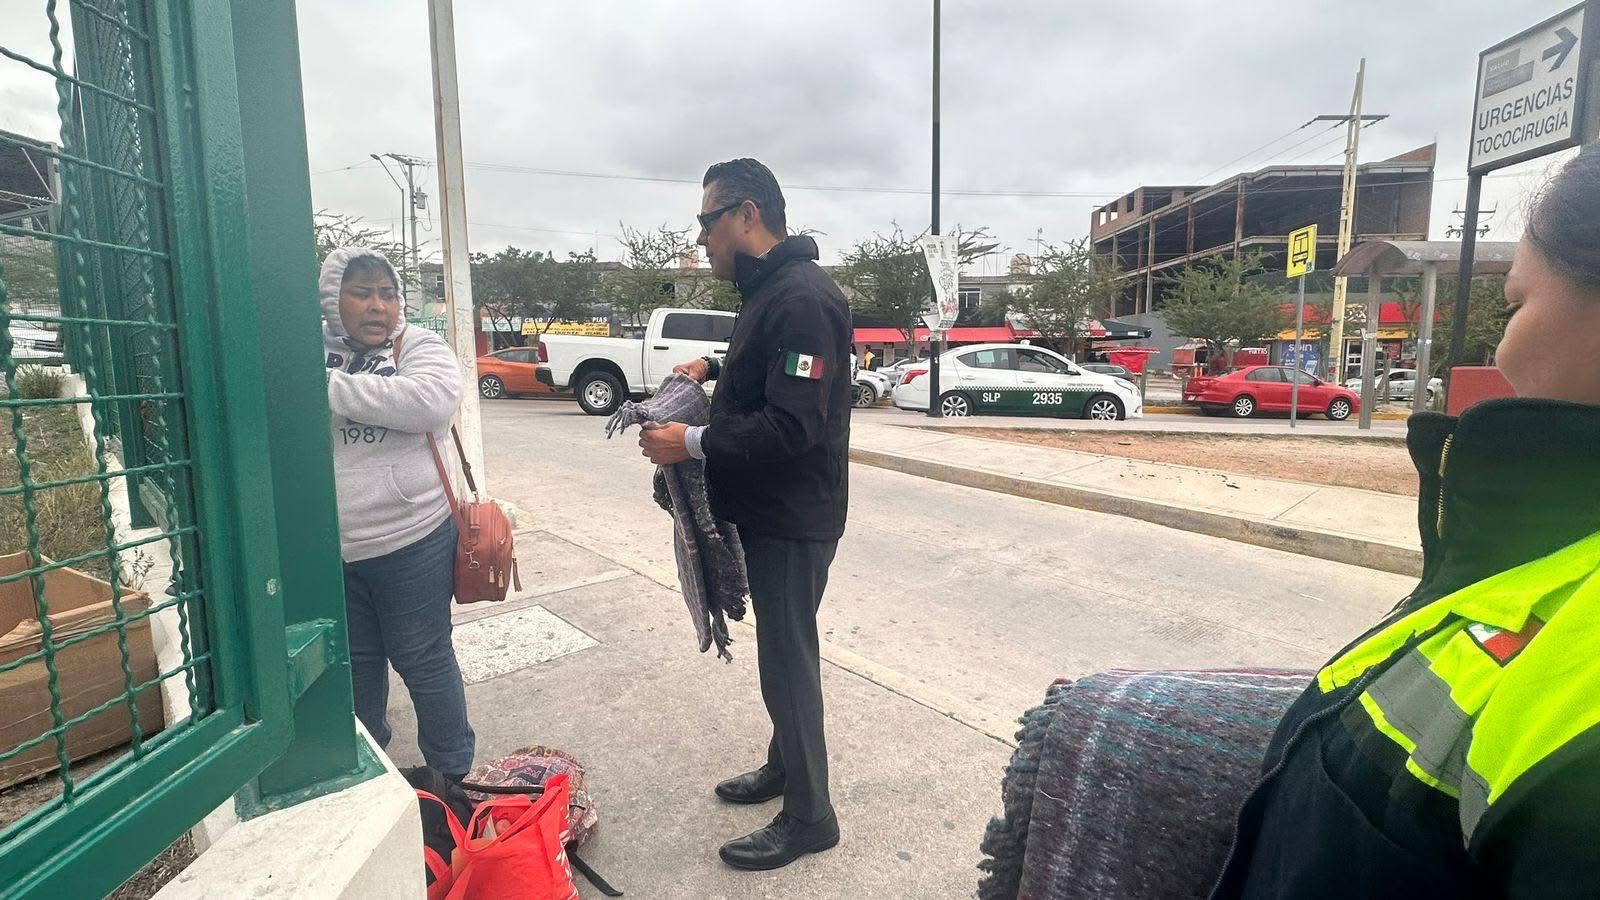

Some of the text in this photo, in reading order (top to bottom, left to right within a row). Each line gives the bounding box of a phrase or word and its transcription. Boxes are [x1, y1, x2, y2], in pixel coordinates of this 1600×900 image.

[1478, 77, 1574, 131] URGENCIAS
[1476, 107, 1569, 156] TOCOCIRUGÍA
[982, 392, 1062, 405] SLP 2935
[340, 426, 388, 445] 1987
